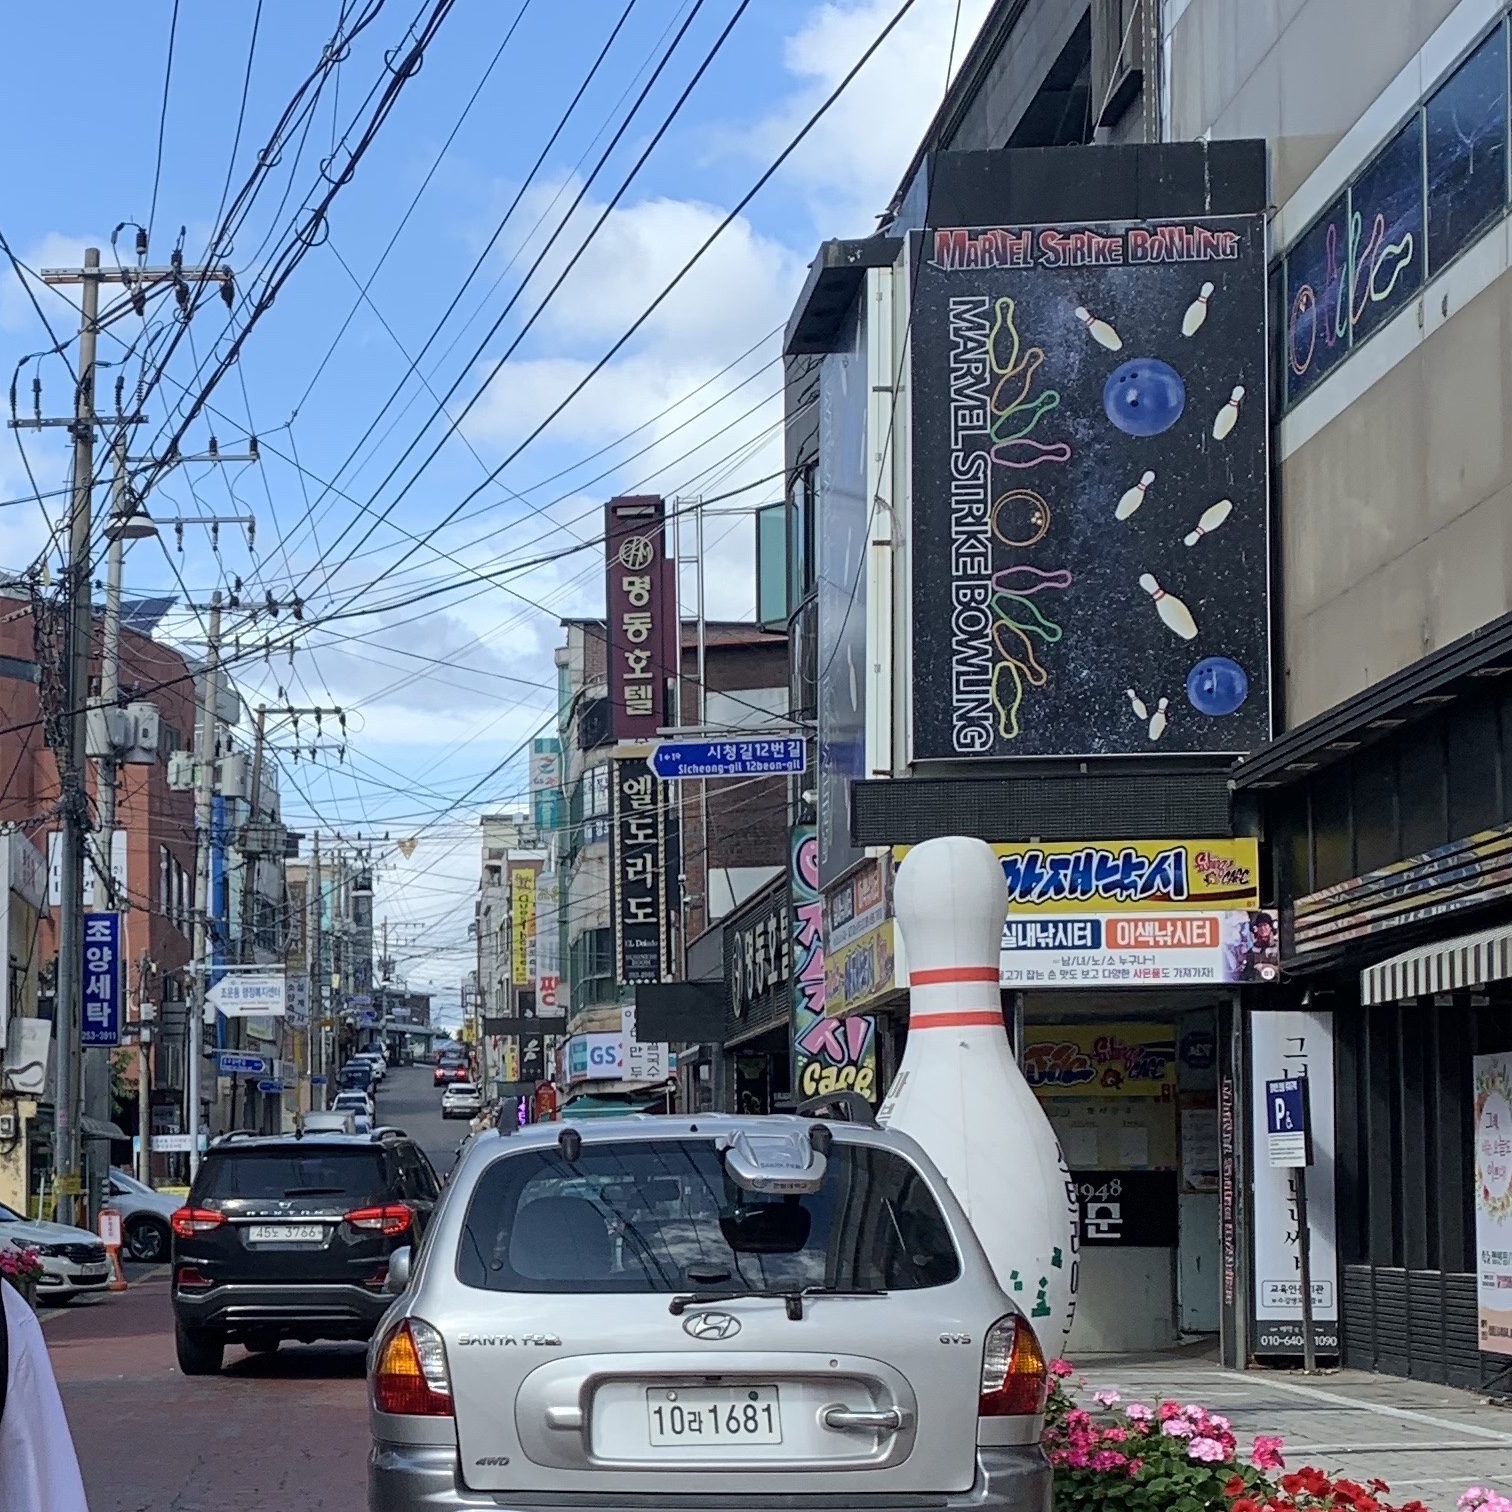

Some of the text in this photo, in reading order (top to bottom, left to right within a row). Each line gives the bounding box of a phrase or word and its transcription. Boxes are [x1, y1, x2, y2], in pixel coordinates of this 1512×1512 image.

[930, 226, 1240, 271] MARVEL STRIKE BOWLING
[949, 296, 994, 753] MARVEL STRIKE BOWLING
[622, 575, 653, 716] 명동호텔
[707, 741, 801, 761] 시청길12번길
[678, 759, 801, 776] Sicheong-gil 12beon-gil
[623, 774, 658, 924] 엘도라도
[1001, 922, 1093, 948] 실내낚시터
[1116, 919, 1211, 946] 이색낚시터
[85, 919, 113, 1028] 조양세탁
[1081, 969, 1099, 979] 보고
[1274, 1097, 1286, 1131] P
[285, 1226, 316, 1238] 3766
[458, 1332, 545, 1347] SANTA FE
[940, 1333, 971, 1345] GVS
[653, 1403, 774, 1436] 10라1681
[475, 1456, 510, 1467] 4WD
